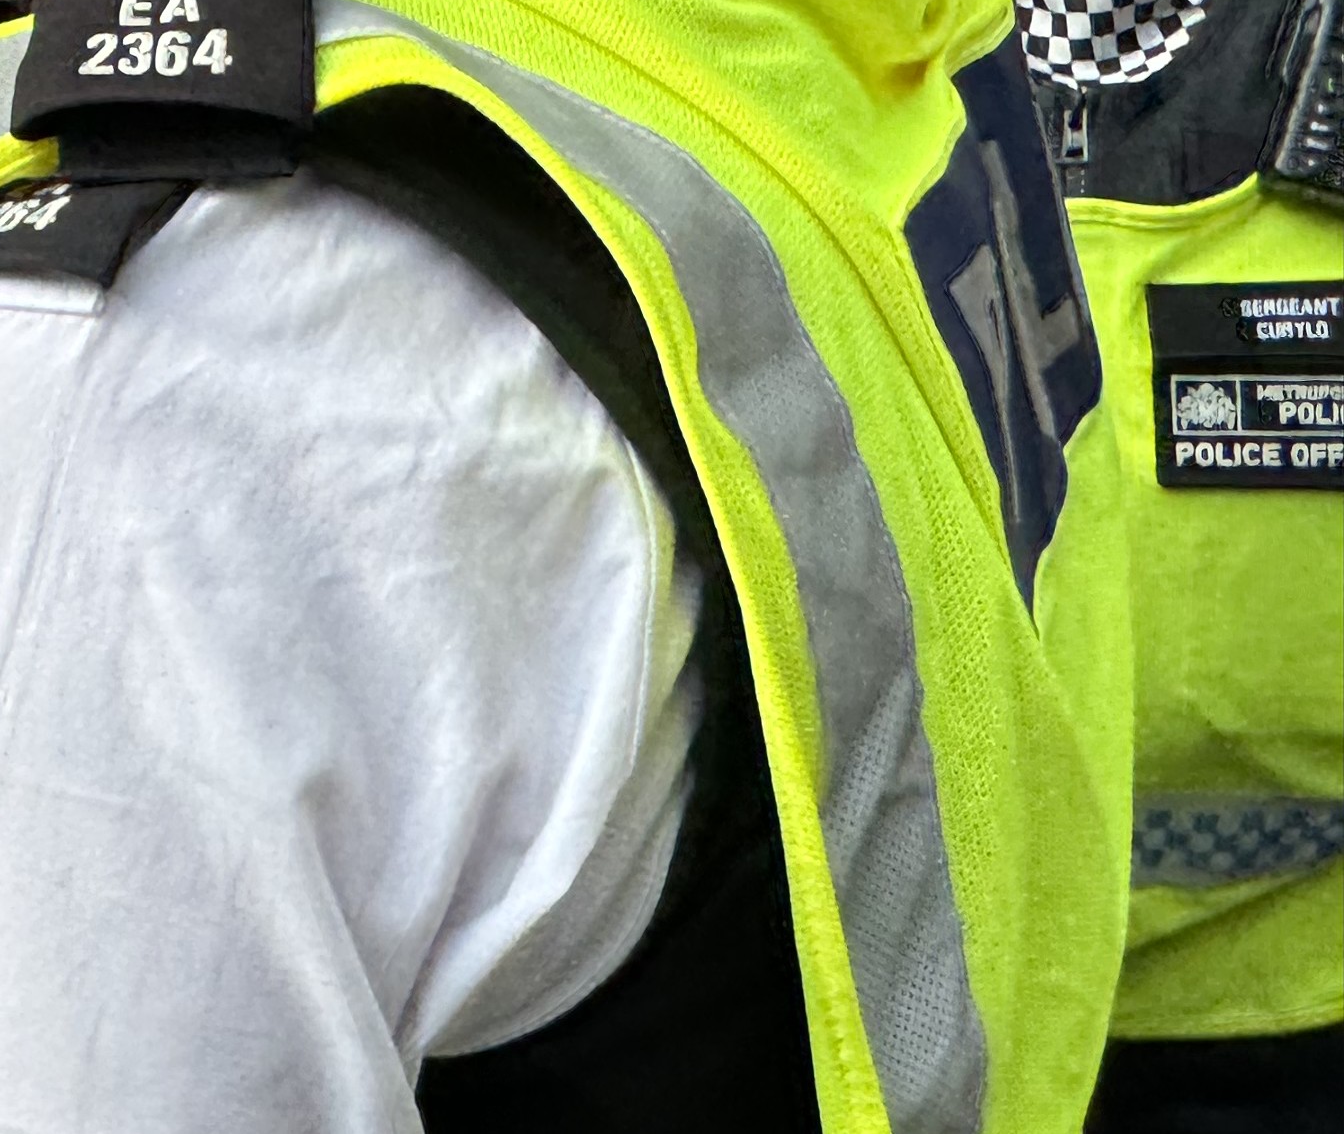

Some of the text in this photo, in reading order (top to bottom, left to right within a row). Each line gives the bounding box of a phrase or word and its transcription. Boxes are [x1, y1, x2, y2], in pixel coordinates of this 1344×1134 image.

[78, 28, 233, 76] 2364
[1240, 296, 1341, 317] SERGEANT
[1279, 401, 1344, 425] POLI
[1175, 441, 1283, 467] POLICE
